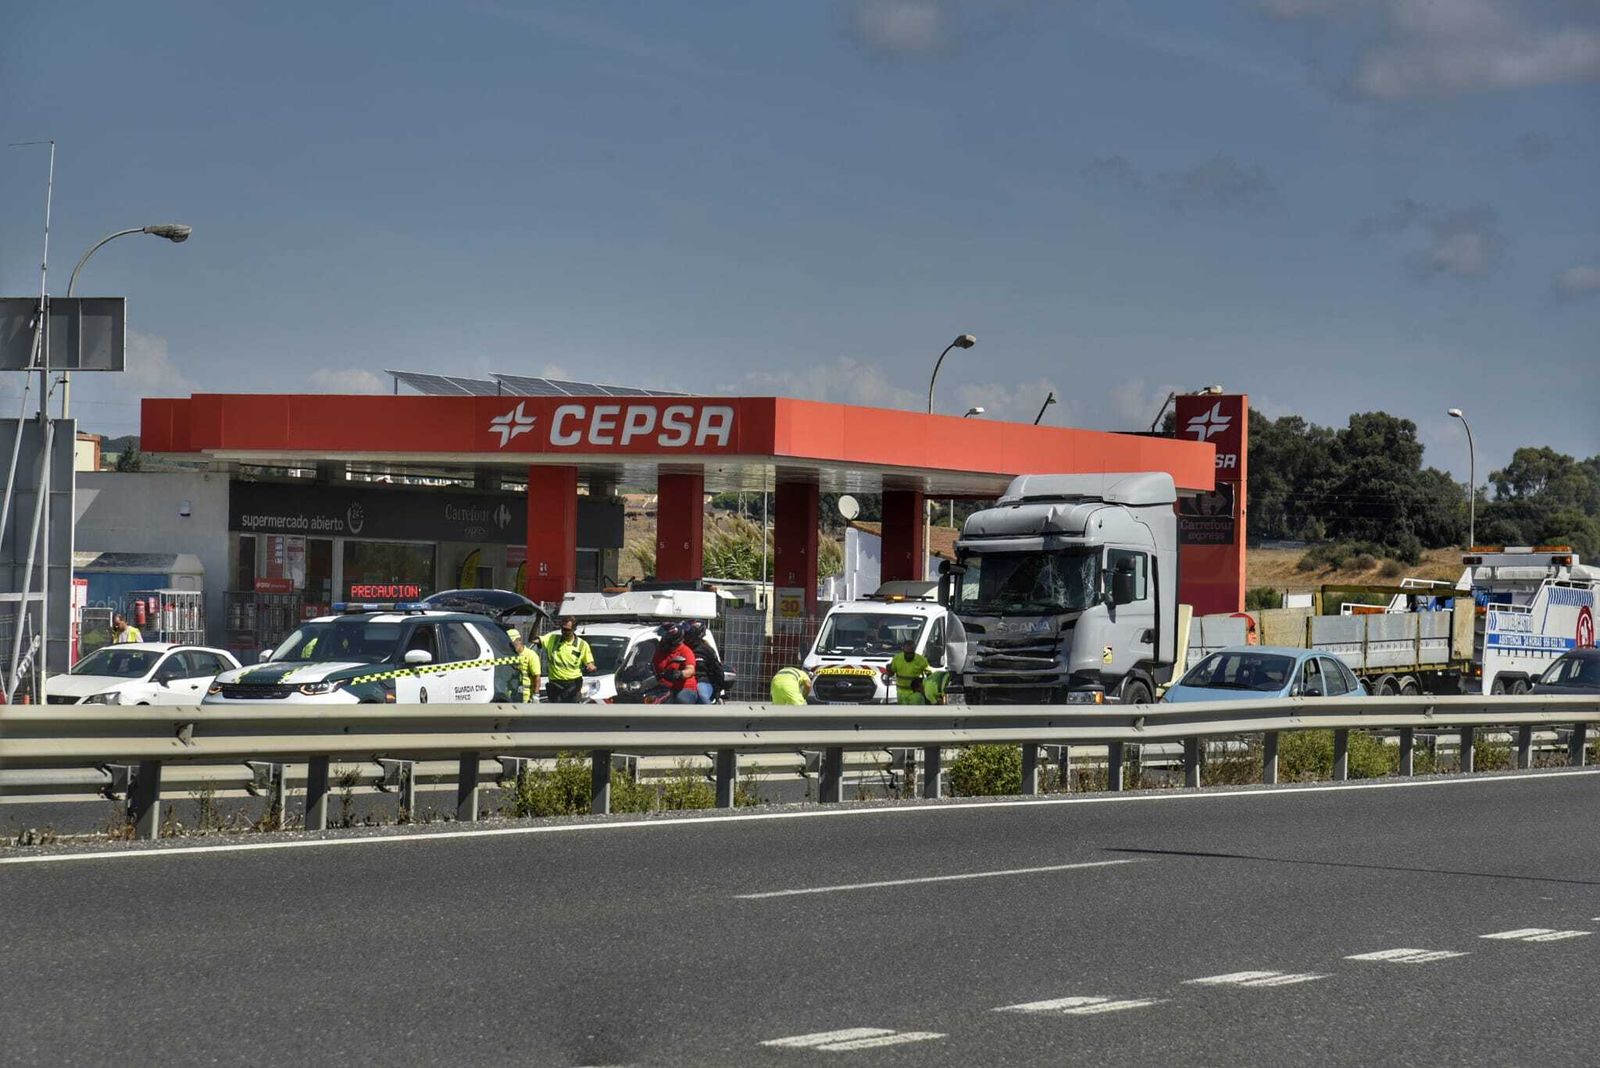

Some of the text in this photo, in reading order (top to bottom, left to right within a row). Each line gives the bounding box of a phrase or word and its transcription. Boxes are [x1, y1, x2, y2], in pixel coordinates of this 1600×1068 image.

[549, 403, 734, 448] CEPSA
[445, 503, 490, 521] Carrefour
[242, 515, 344, 531] supermercado abierto
[1180, 519, 1233, 530] Carrefour
[351, 585, 419, 599] PRECAUCION
[781, 599, 800, 613] 30
[998, 621, 1051, 633] SCANIA
[454, 684, 487, 694] GUARDIA CIVIL
